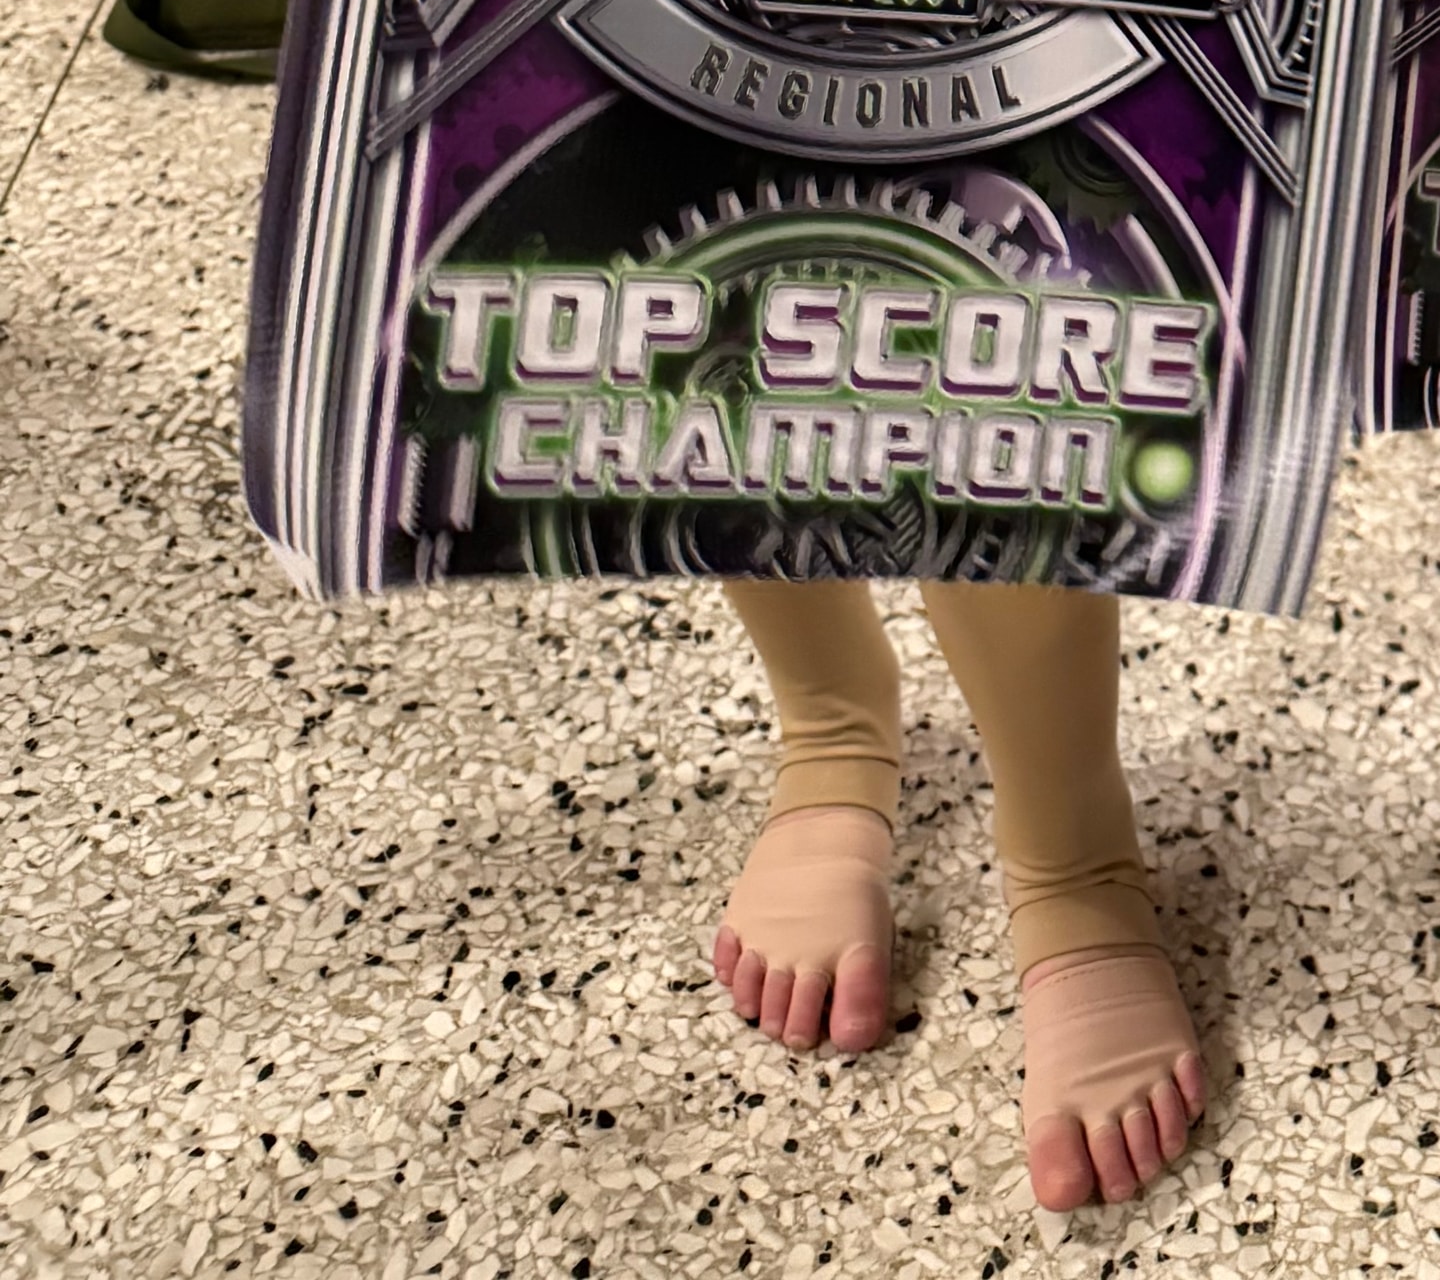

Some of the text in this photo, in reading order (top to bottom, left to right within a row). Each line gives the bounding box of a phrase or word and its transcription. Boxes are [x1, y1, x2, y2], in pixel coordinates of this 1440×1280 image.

[690, 43, 1022, 129] REGIONAL
[424, 267, 1214, 414] TOP SCORE
[489, 394, 1120, 512] CHAMPION
